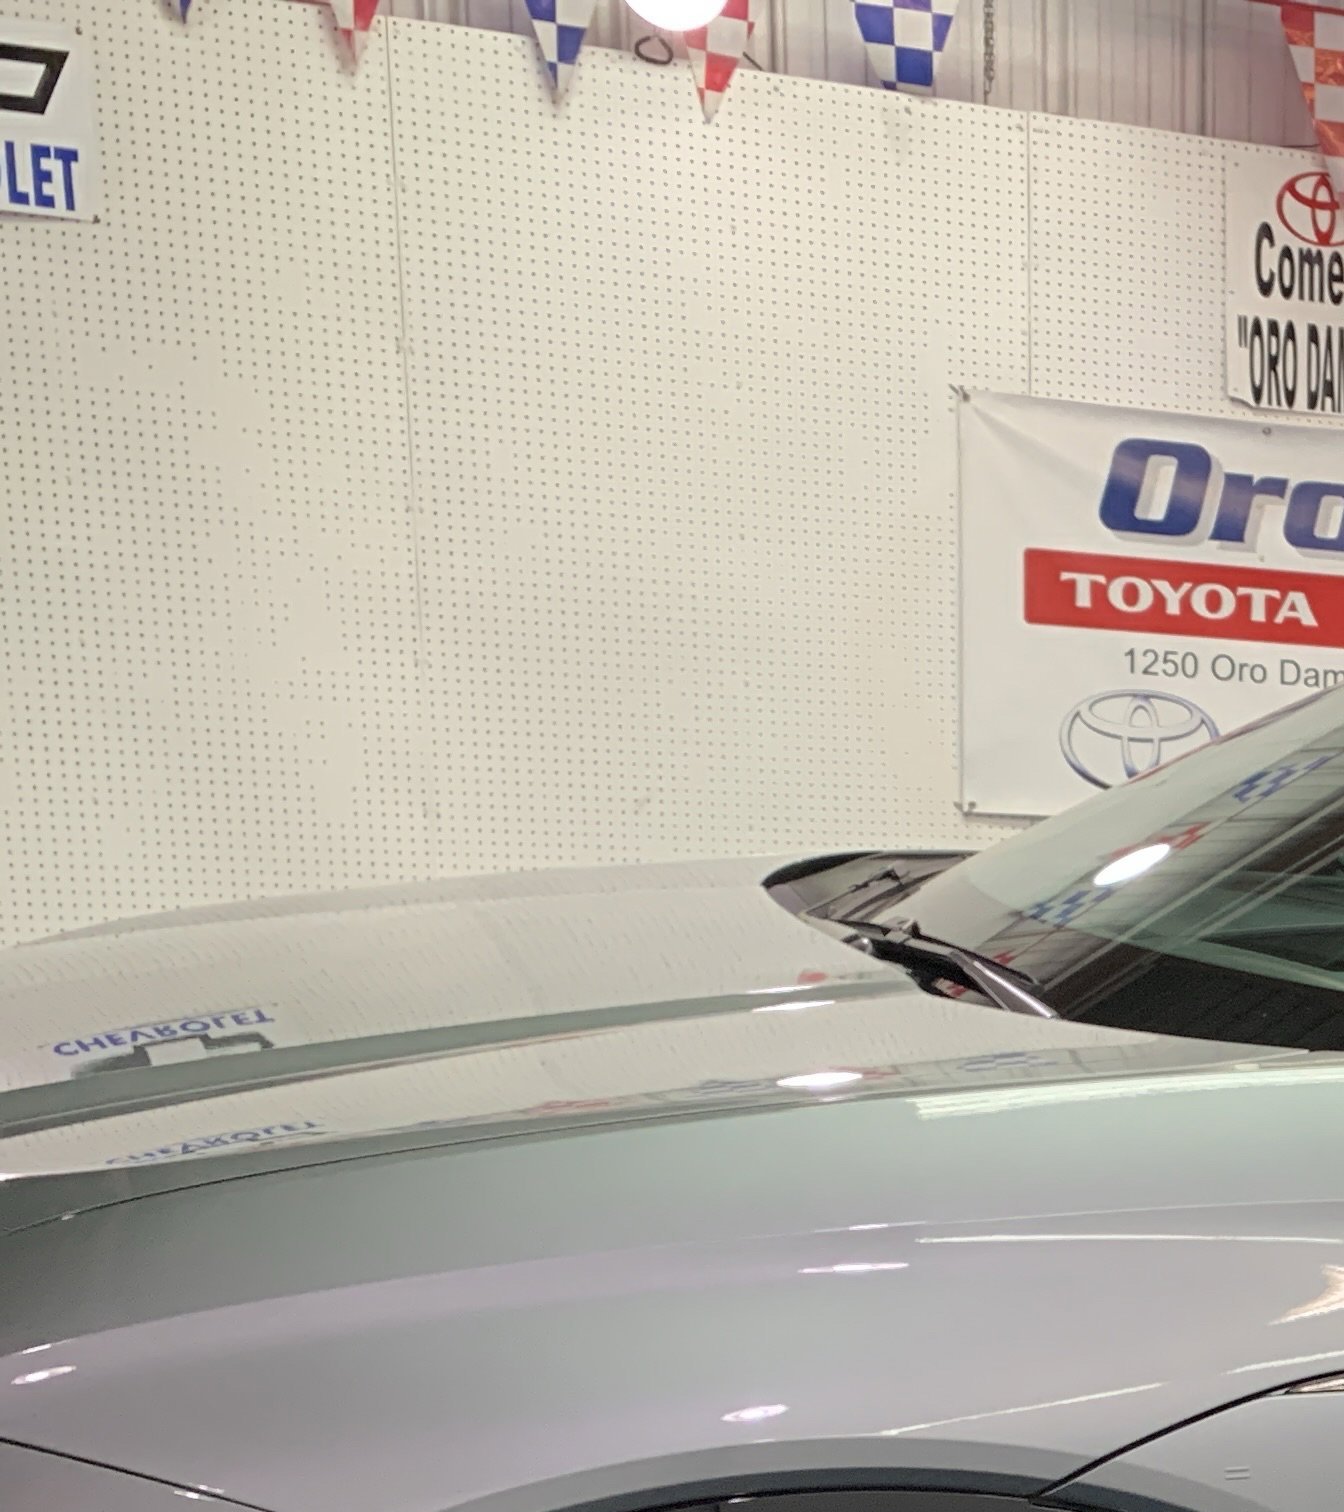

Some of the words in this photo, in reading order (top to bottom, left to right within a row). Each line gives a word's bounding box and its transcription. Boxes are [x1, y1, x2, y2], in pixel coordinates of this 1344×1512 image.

[1254, 221, 1344, 304] Come
[1237, 314, 1297, 410] "ORO
[1059, 571, 1319, 628] TOYOTA
[1124, 647, 1199, 679] 1250
[1211, 653, 1268, 684] Oro
